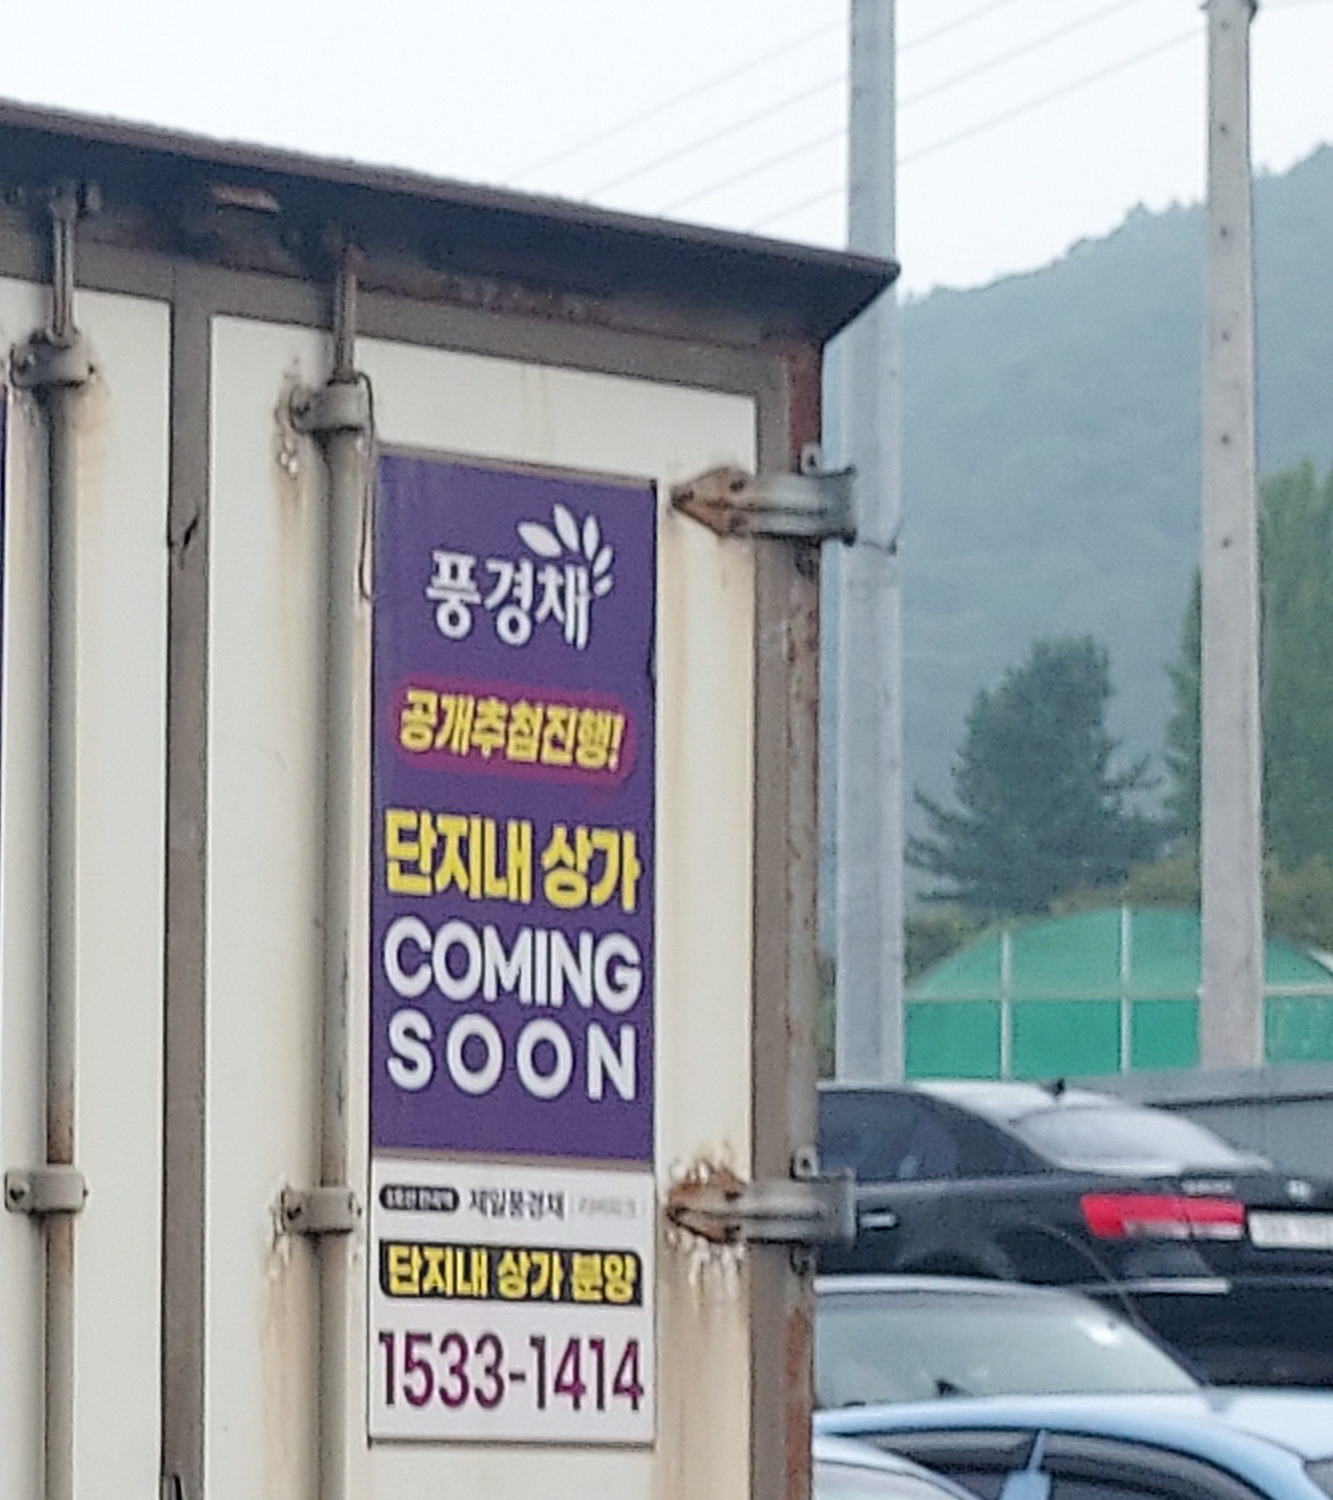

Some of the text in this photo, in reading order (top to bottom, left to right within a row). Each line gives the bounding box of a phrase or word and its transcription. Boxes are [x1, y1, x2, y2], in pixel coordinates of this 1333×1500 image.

[426, 549, 590, 651] 풍경채
[384, 808, 641, 913] 단지내 상가
[384, 915, 643, 1013] COMING
[387, 1008, 635, 1100] SOON
[389, 1245, 637, 1303] 단지내 상가 분양
[379, 1331, 644, 1411] 1533-1414
